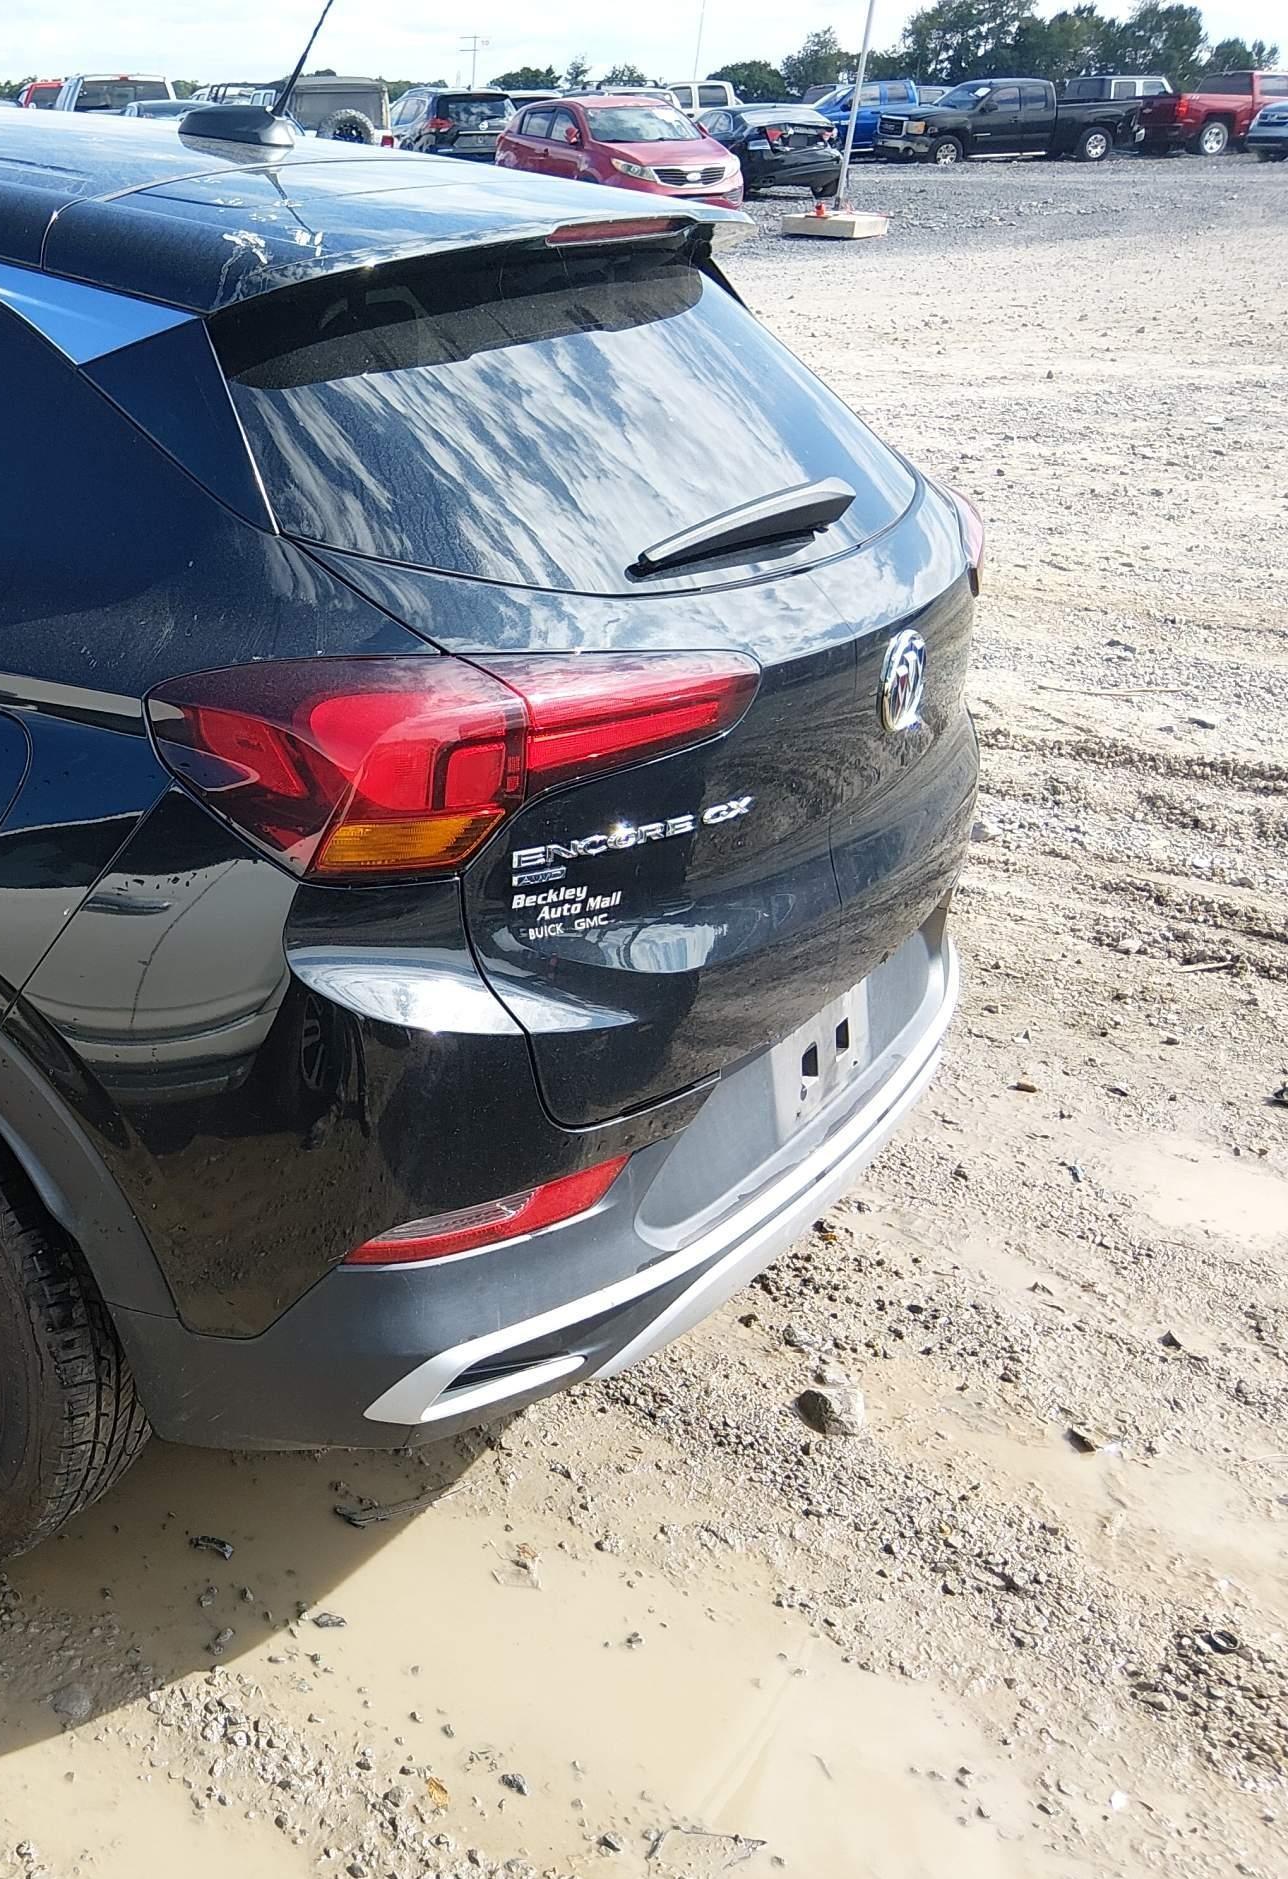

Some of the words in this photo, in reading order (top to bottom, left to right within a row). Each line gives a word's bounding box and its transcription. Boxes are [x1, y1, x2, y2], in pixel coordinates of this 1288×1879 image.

[512, 815, 694, 868] ENCORE
[702, 796, 753, 824] GX
[511, 885, 588, 910] Beckley
[536, 903, 582, 921] Auto
[585, 890, 622, 912] Mall
[528, 922, 564, 940] BUICK
[574, 913, 609, 931] GMC
